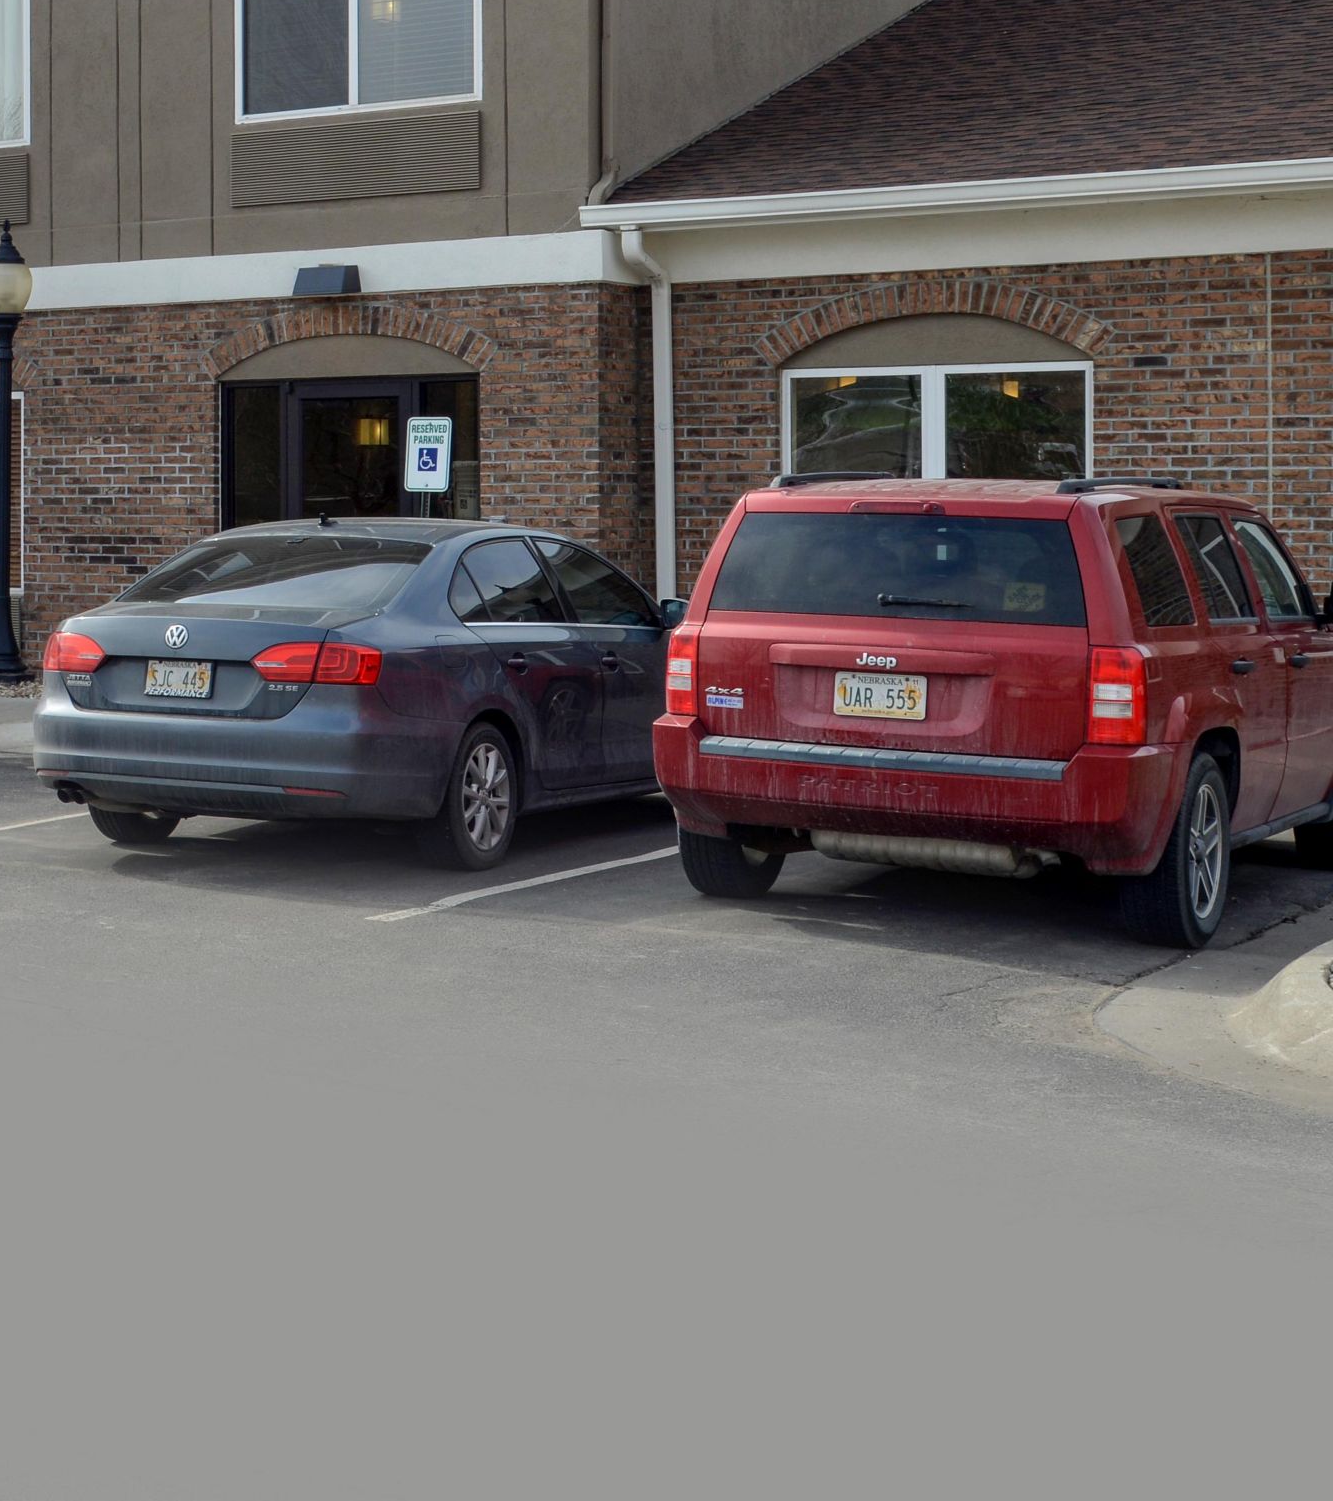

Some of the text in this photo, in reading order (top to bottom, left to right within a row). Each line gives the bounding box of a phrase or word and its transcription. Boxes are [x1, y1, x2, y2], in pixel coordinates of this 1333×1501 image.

[411, 424, 448, 434] RESERVED
[413, 435, 445, 445] PARKING
[163, 660, 196, 668] NEBRASKA
[856, 652, 897, 669] Jeep
[150, 669, 207, 689] SJC 445
[857, 675, 903, 686] NEBRASKA
[144, 687, 209, 698] PERFORMANCE
[843, 685, 917, 711] UAR 555
[798, 774, 939, 797] PATRIOT
